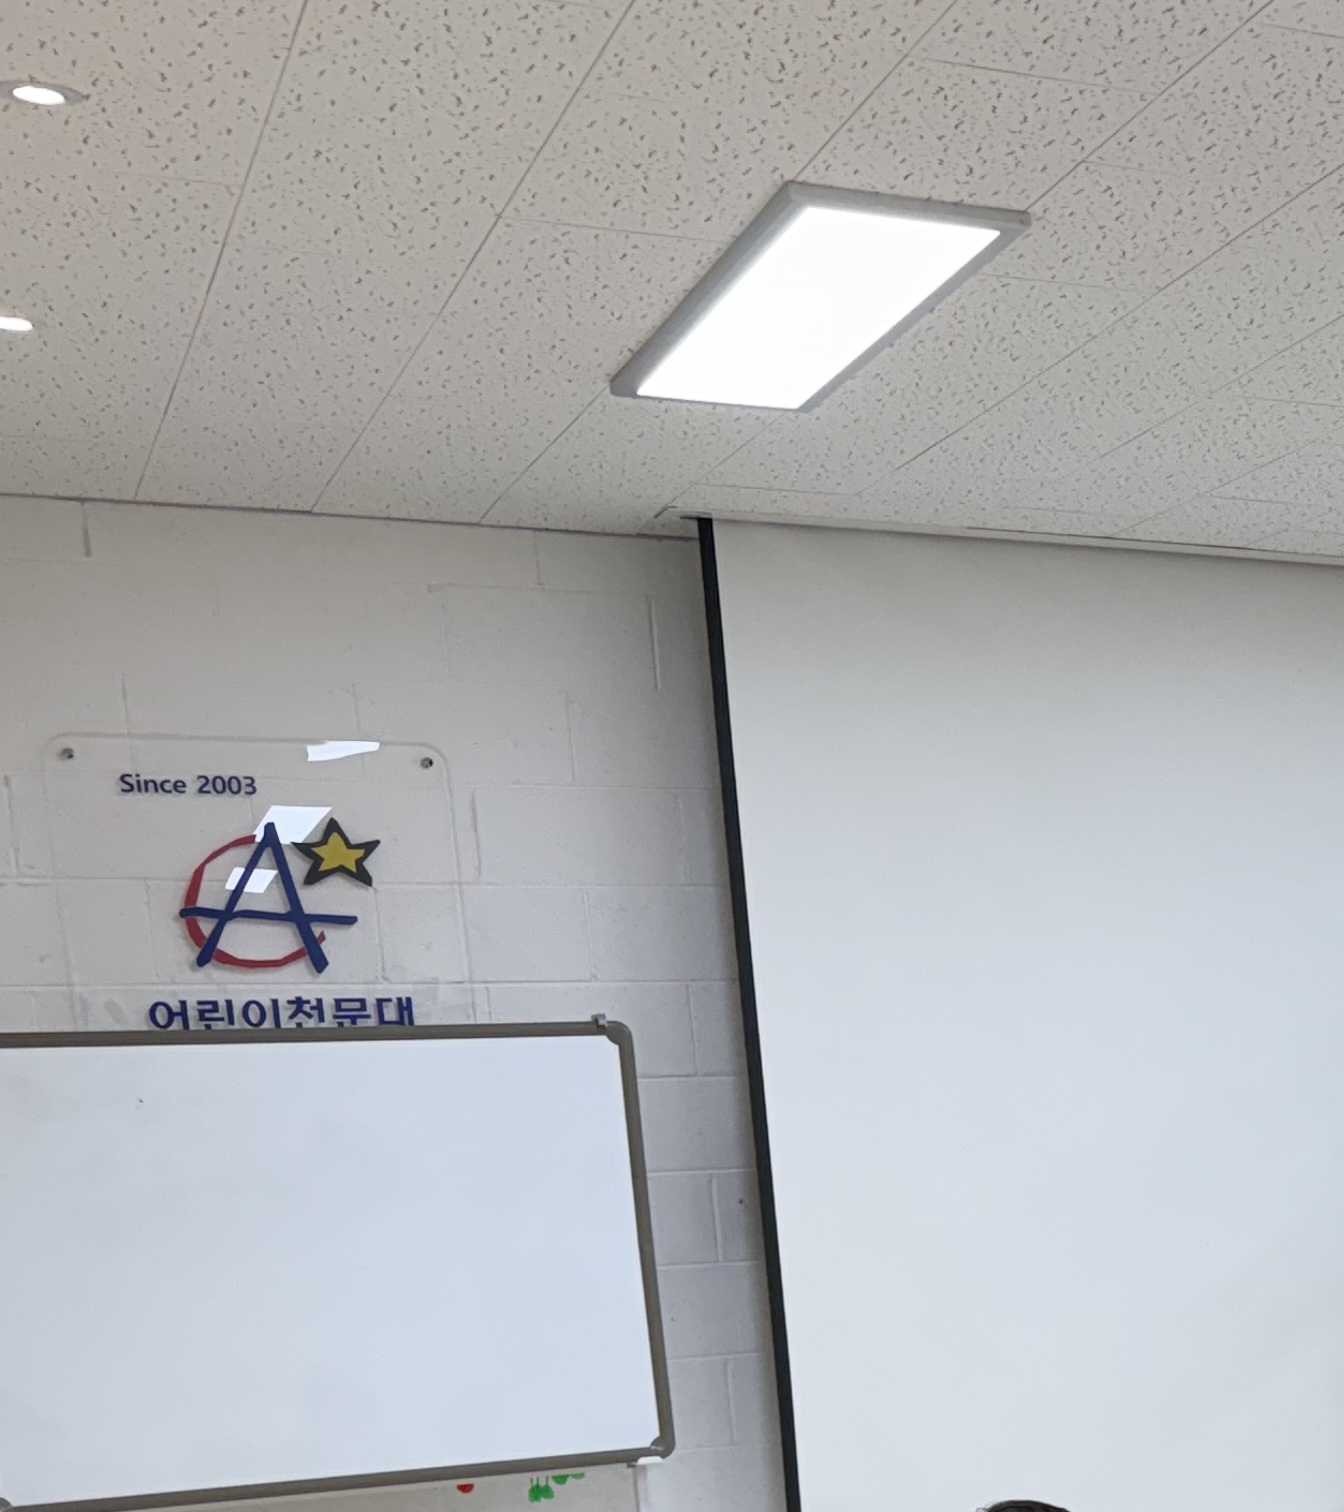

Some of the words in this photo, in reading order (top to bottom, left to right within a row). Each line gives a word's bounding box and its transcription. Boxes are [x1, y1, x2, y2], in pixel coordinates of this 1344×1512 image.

[119, 773, 187, 794] Since
[196, 775, 257, 795] 2003
[148, 996, 415, 1031] 어린이천문대
